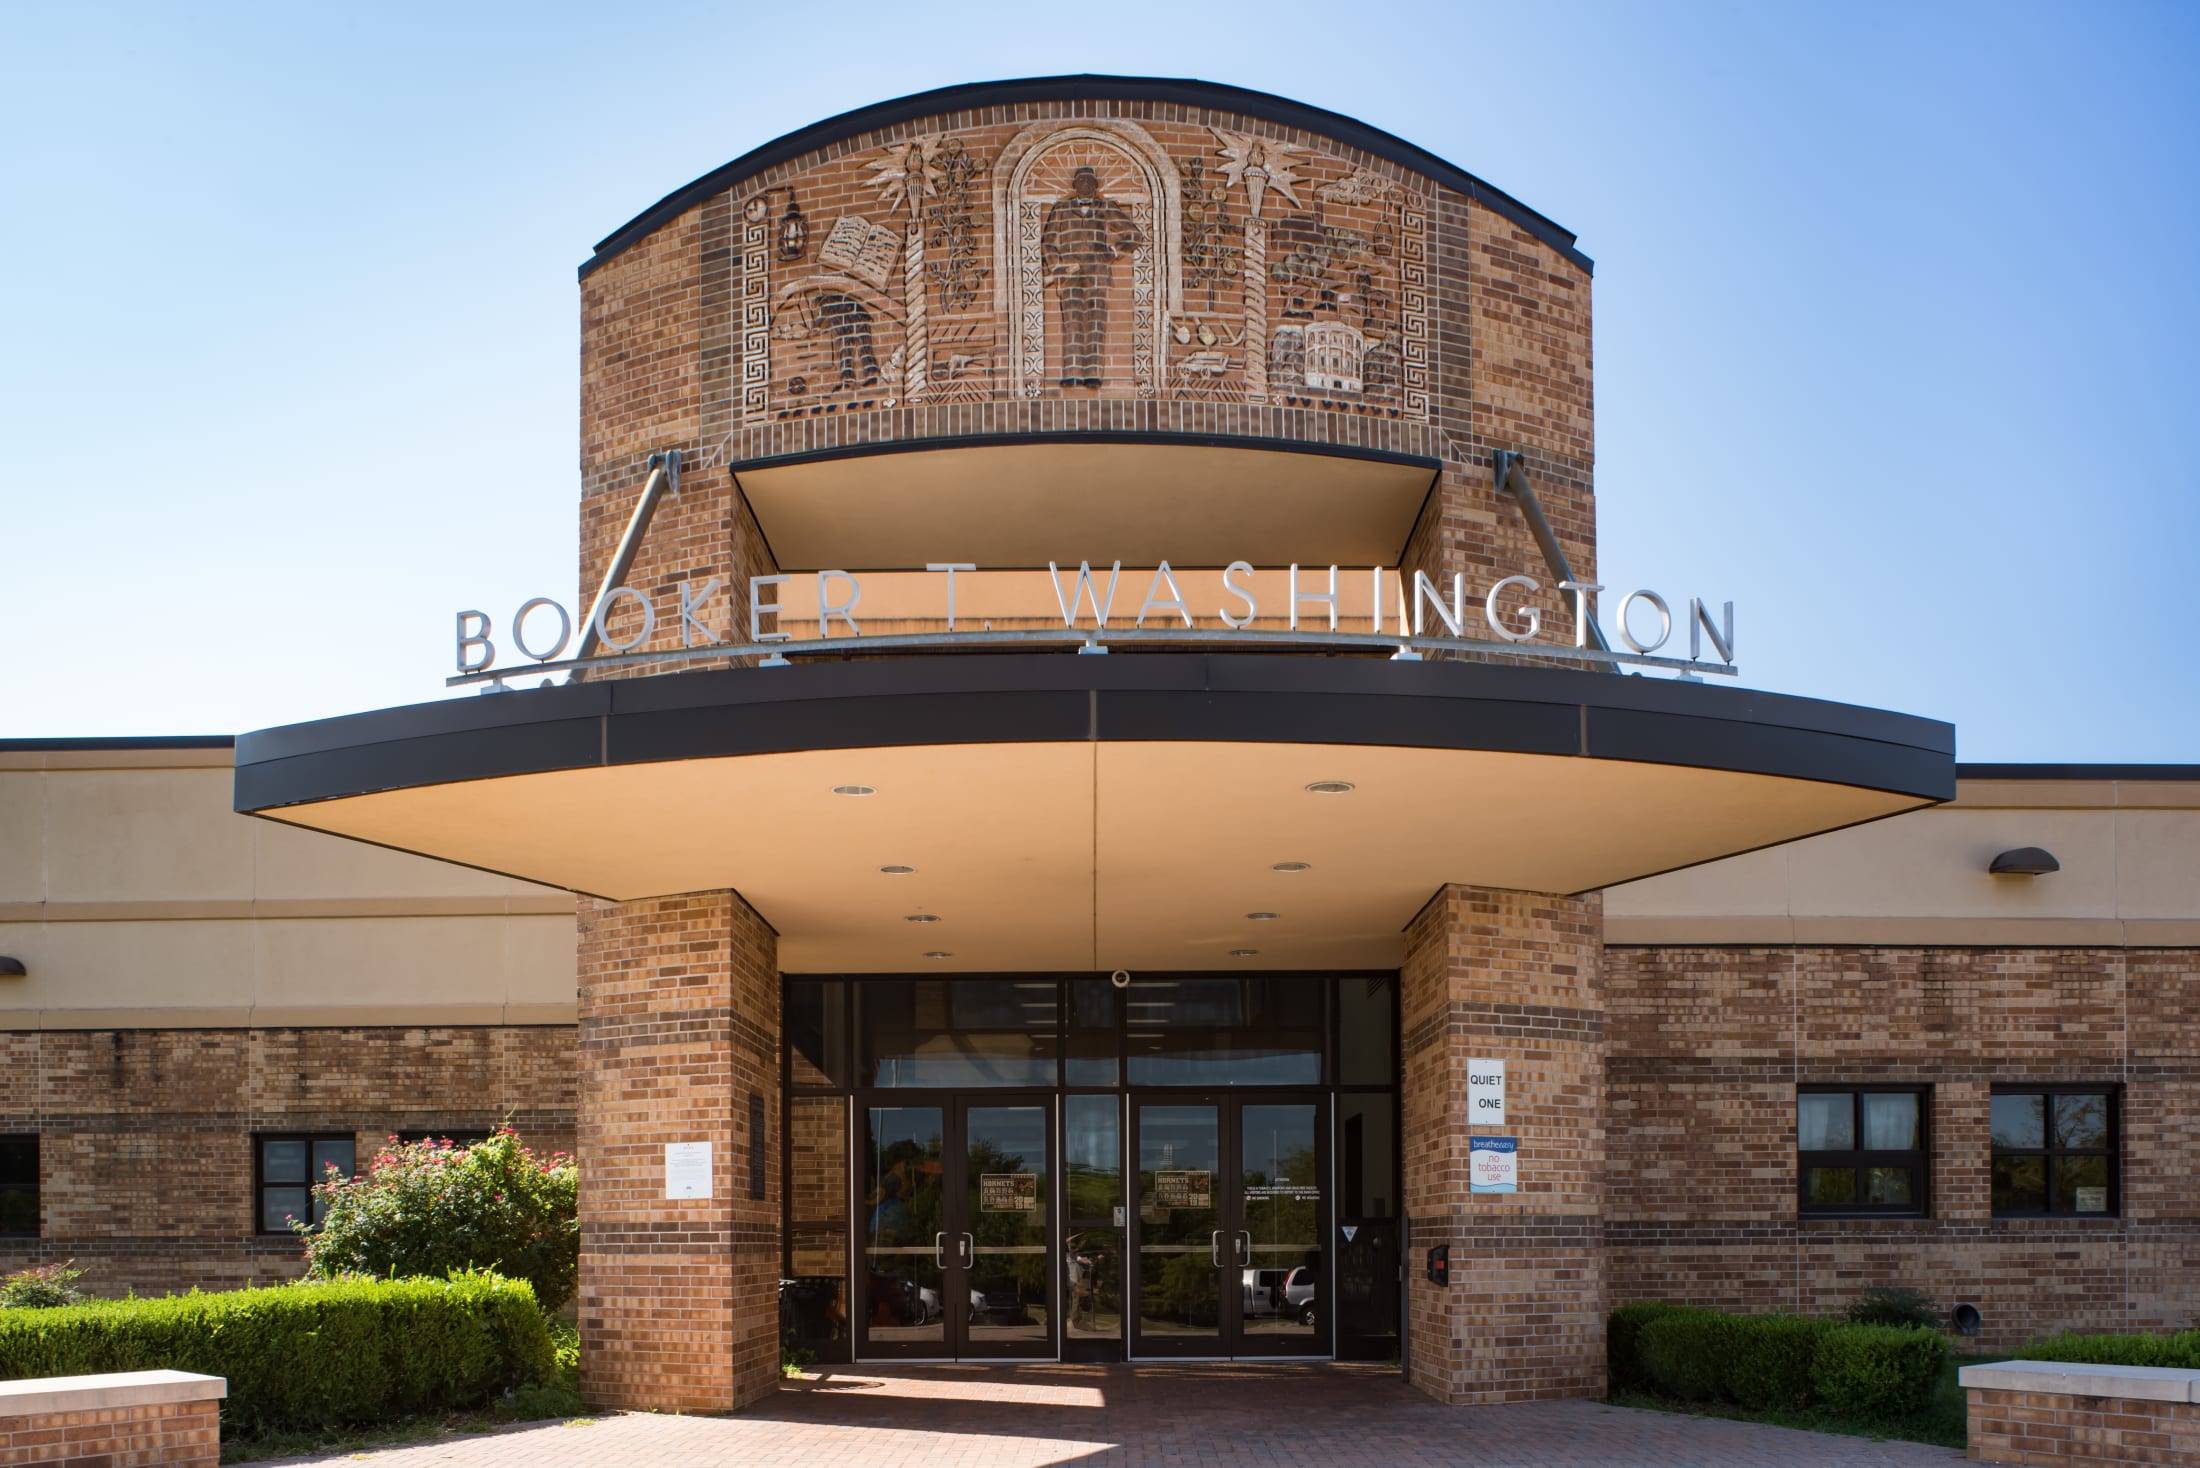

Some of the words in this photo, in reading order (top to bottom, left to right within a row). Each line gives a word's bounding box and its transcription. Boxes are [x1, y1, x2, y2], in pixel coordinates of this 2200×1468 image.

[456, 570, 861, 673] BOOKER
[926, 563, 977, 632] T
[1049, 560, 1734, 664] WASHINGTON
[1470, 1075, 1502, 1085] QUIET
[1479, 1098, 1501, 1109] ONE
[1488, 1155, 1500, 1163] no
[1478, 1162, 1510, 1172] tobacco
